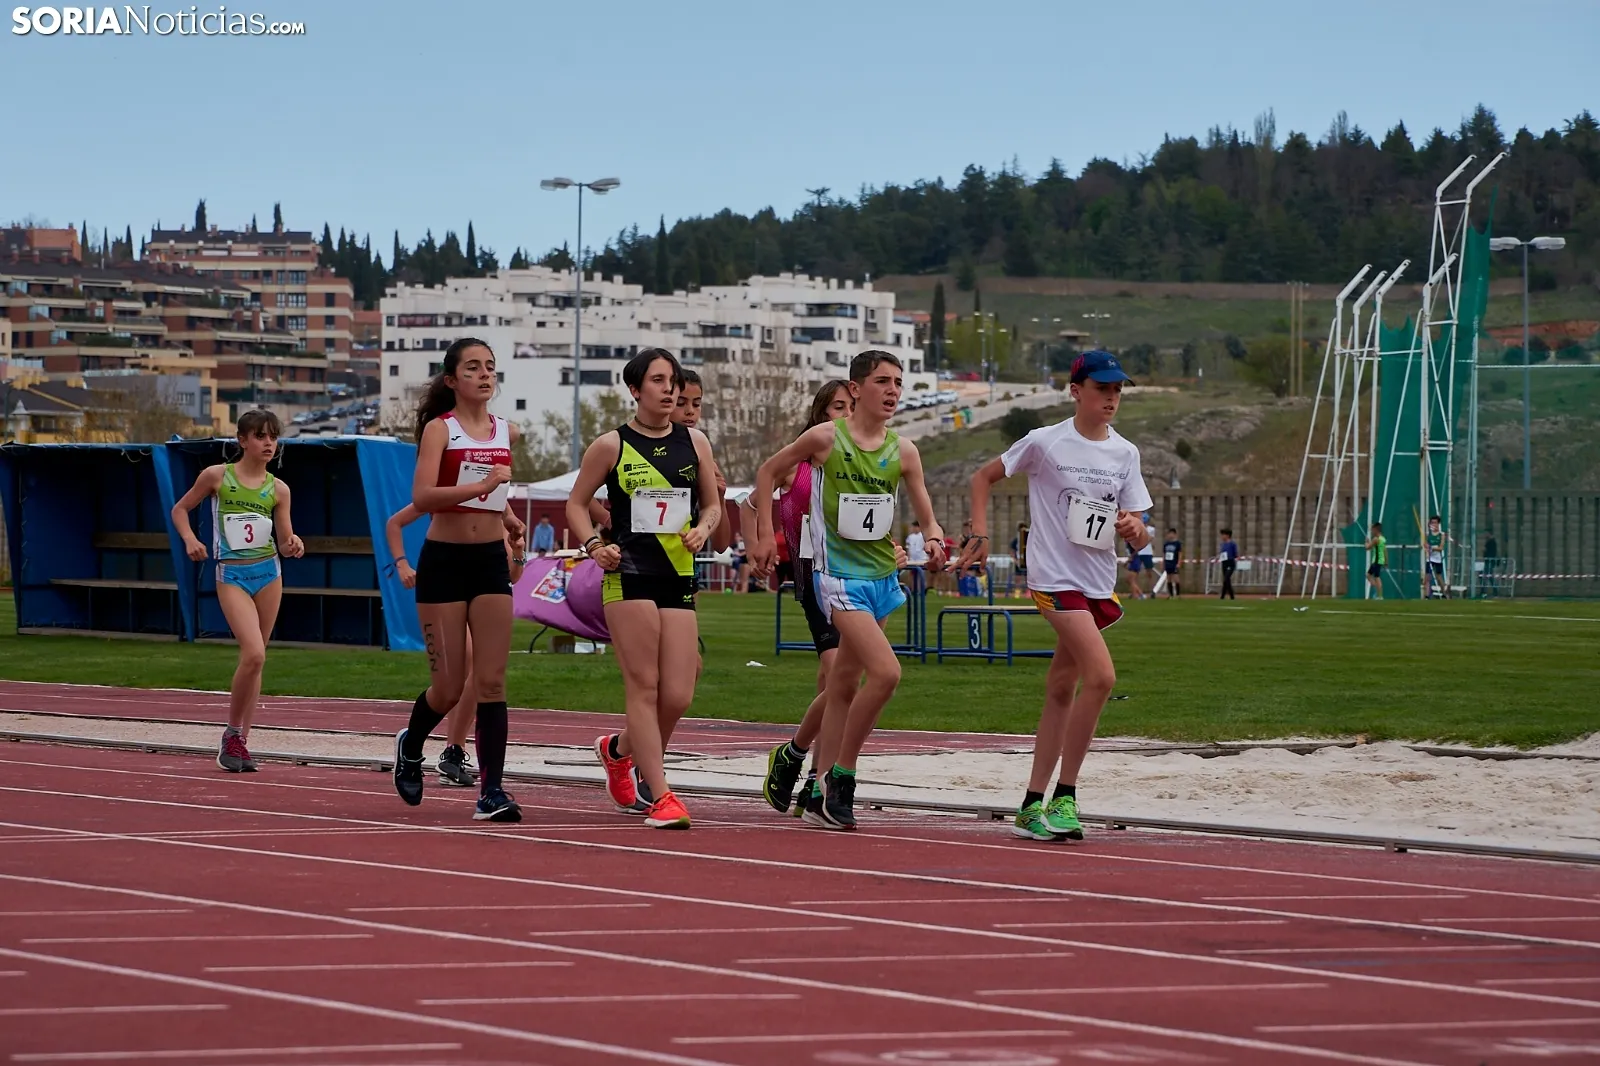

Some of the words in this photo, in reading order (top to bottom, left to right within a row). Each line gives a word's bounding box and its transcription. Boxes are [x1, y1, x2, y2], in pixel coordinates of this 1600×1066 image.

[836, 471, 848, 480] LA
[1056, 464, 1089, 475] CAMPEONATO
[1078, 476, 1102, 485] ATLETISMO
[655, 501, 668, 526] 7
[862, 508, 875, 533] 4
[243, 523, 254, 544] 3
[1085, 513, 1107, 541] 17
[970, 618, 980, 649] 3
